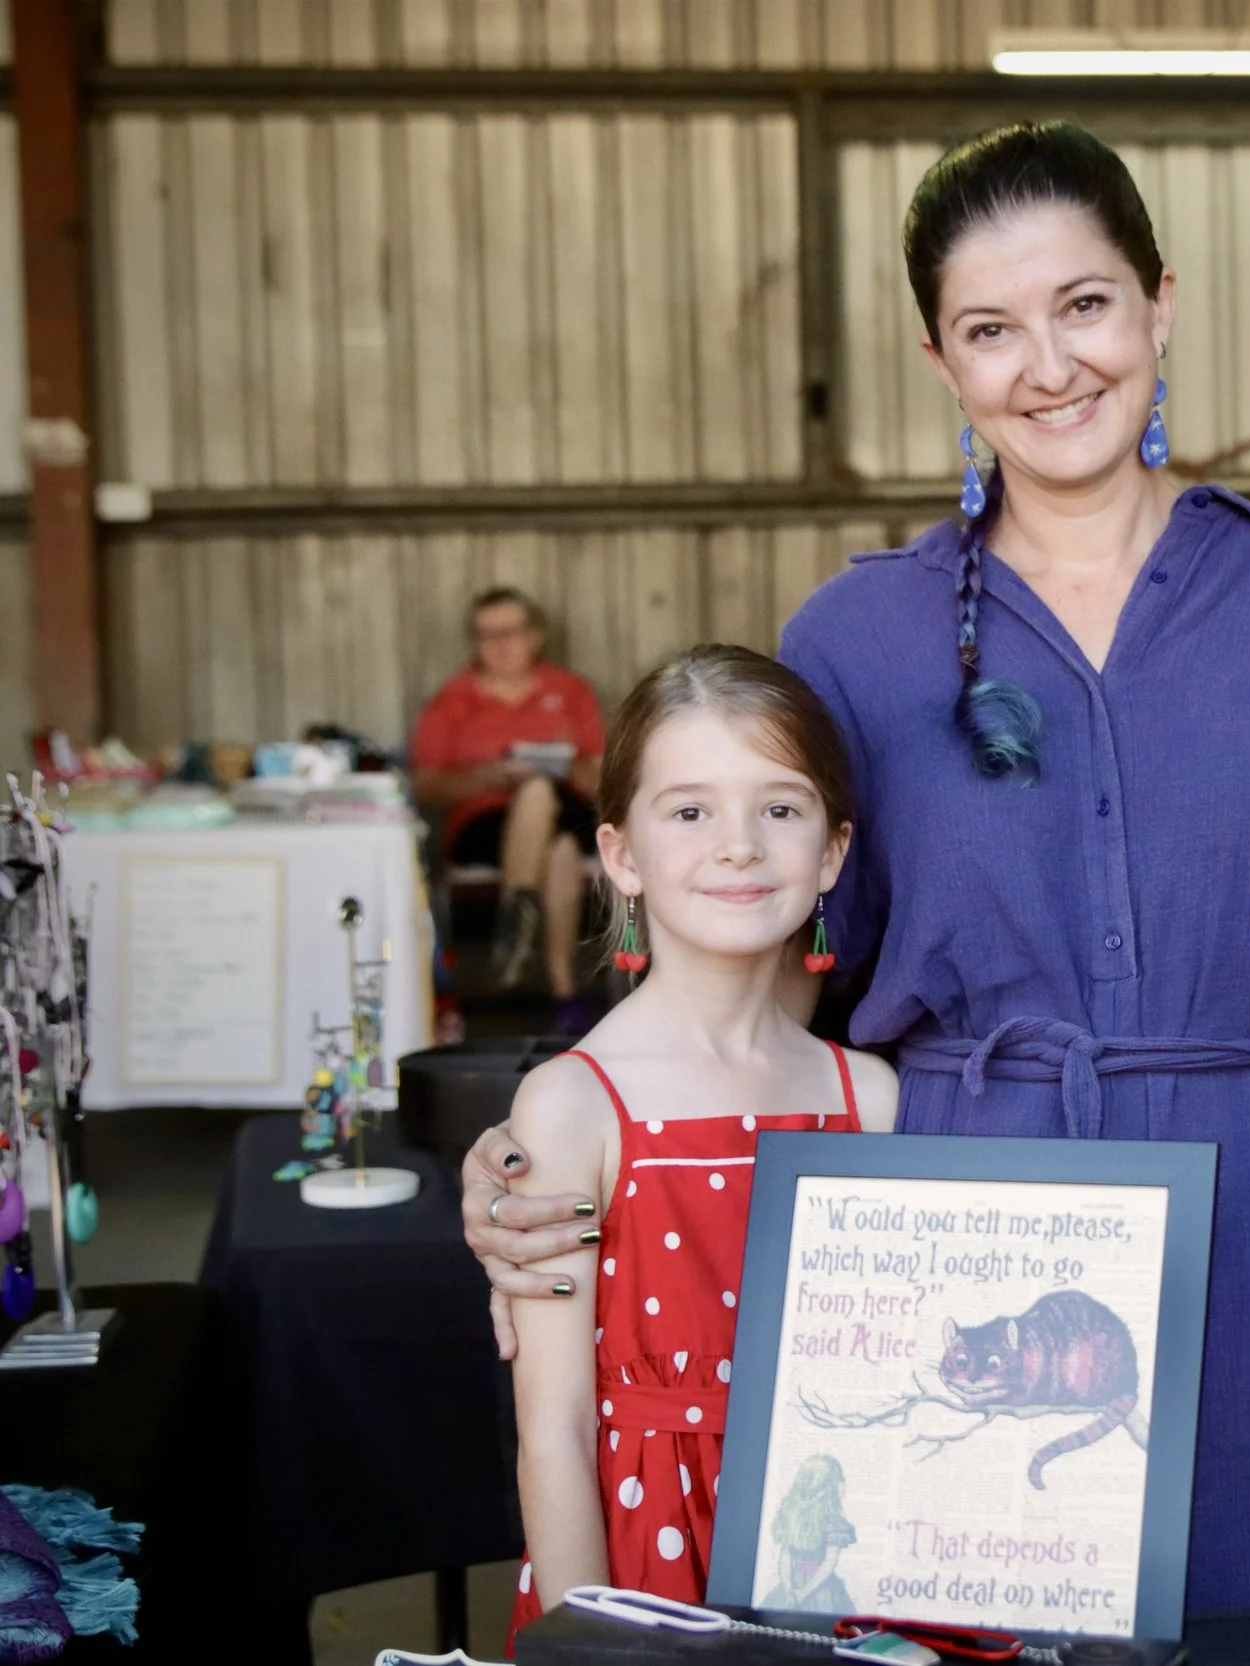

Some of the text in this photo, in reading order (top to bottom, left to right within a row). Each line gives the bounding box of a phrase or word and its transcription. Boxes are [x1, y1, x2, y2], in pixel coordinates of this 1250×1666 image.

[913, 1209, 955, 1241] you
[965, 1209, 1000, 1234] tell
[801, 1242, 1084, 1286] which way I ought to go
[796, 1282, 855, 1319] from
[793, 1329, 841, 1357] said
[977, 1530, 1075, 1568] depends
[1084, 1543, 1099, 1567] a
[877, 1572, 1116, 1613] good deal on where
